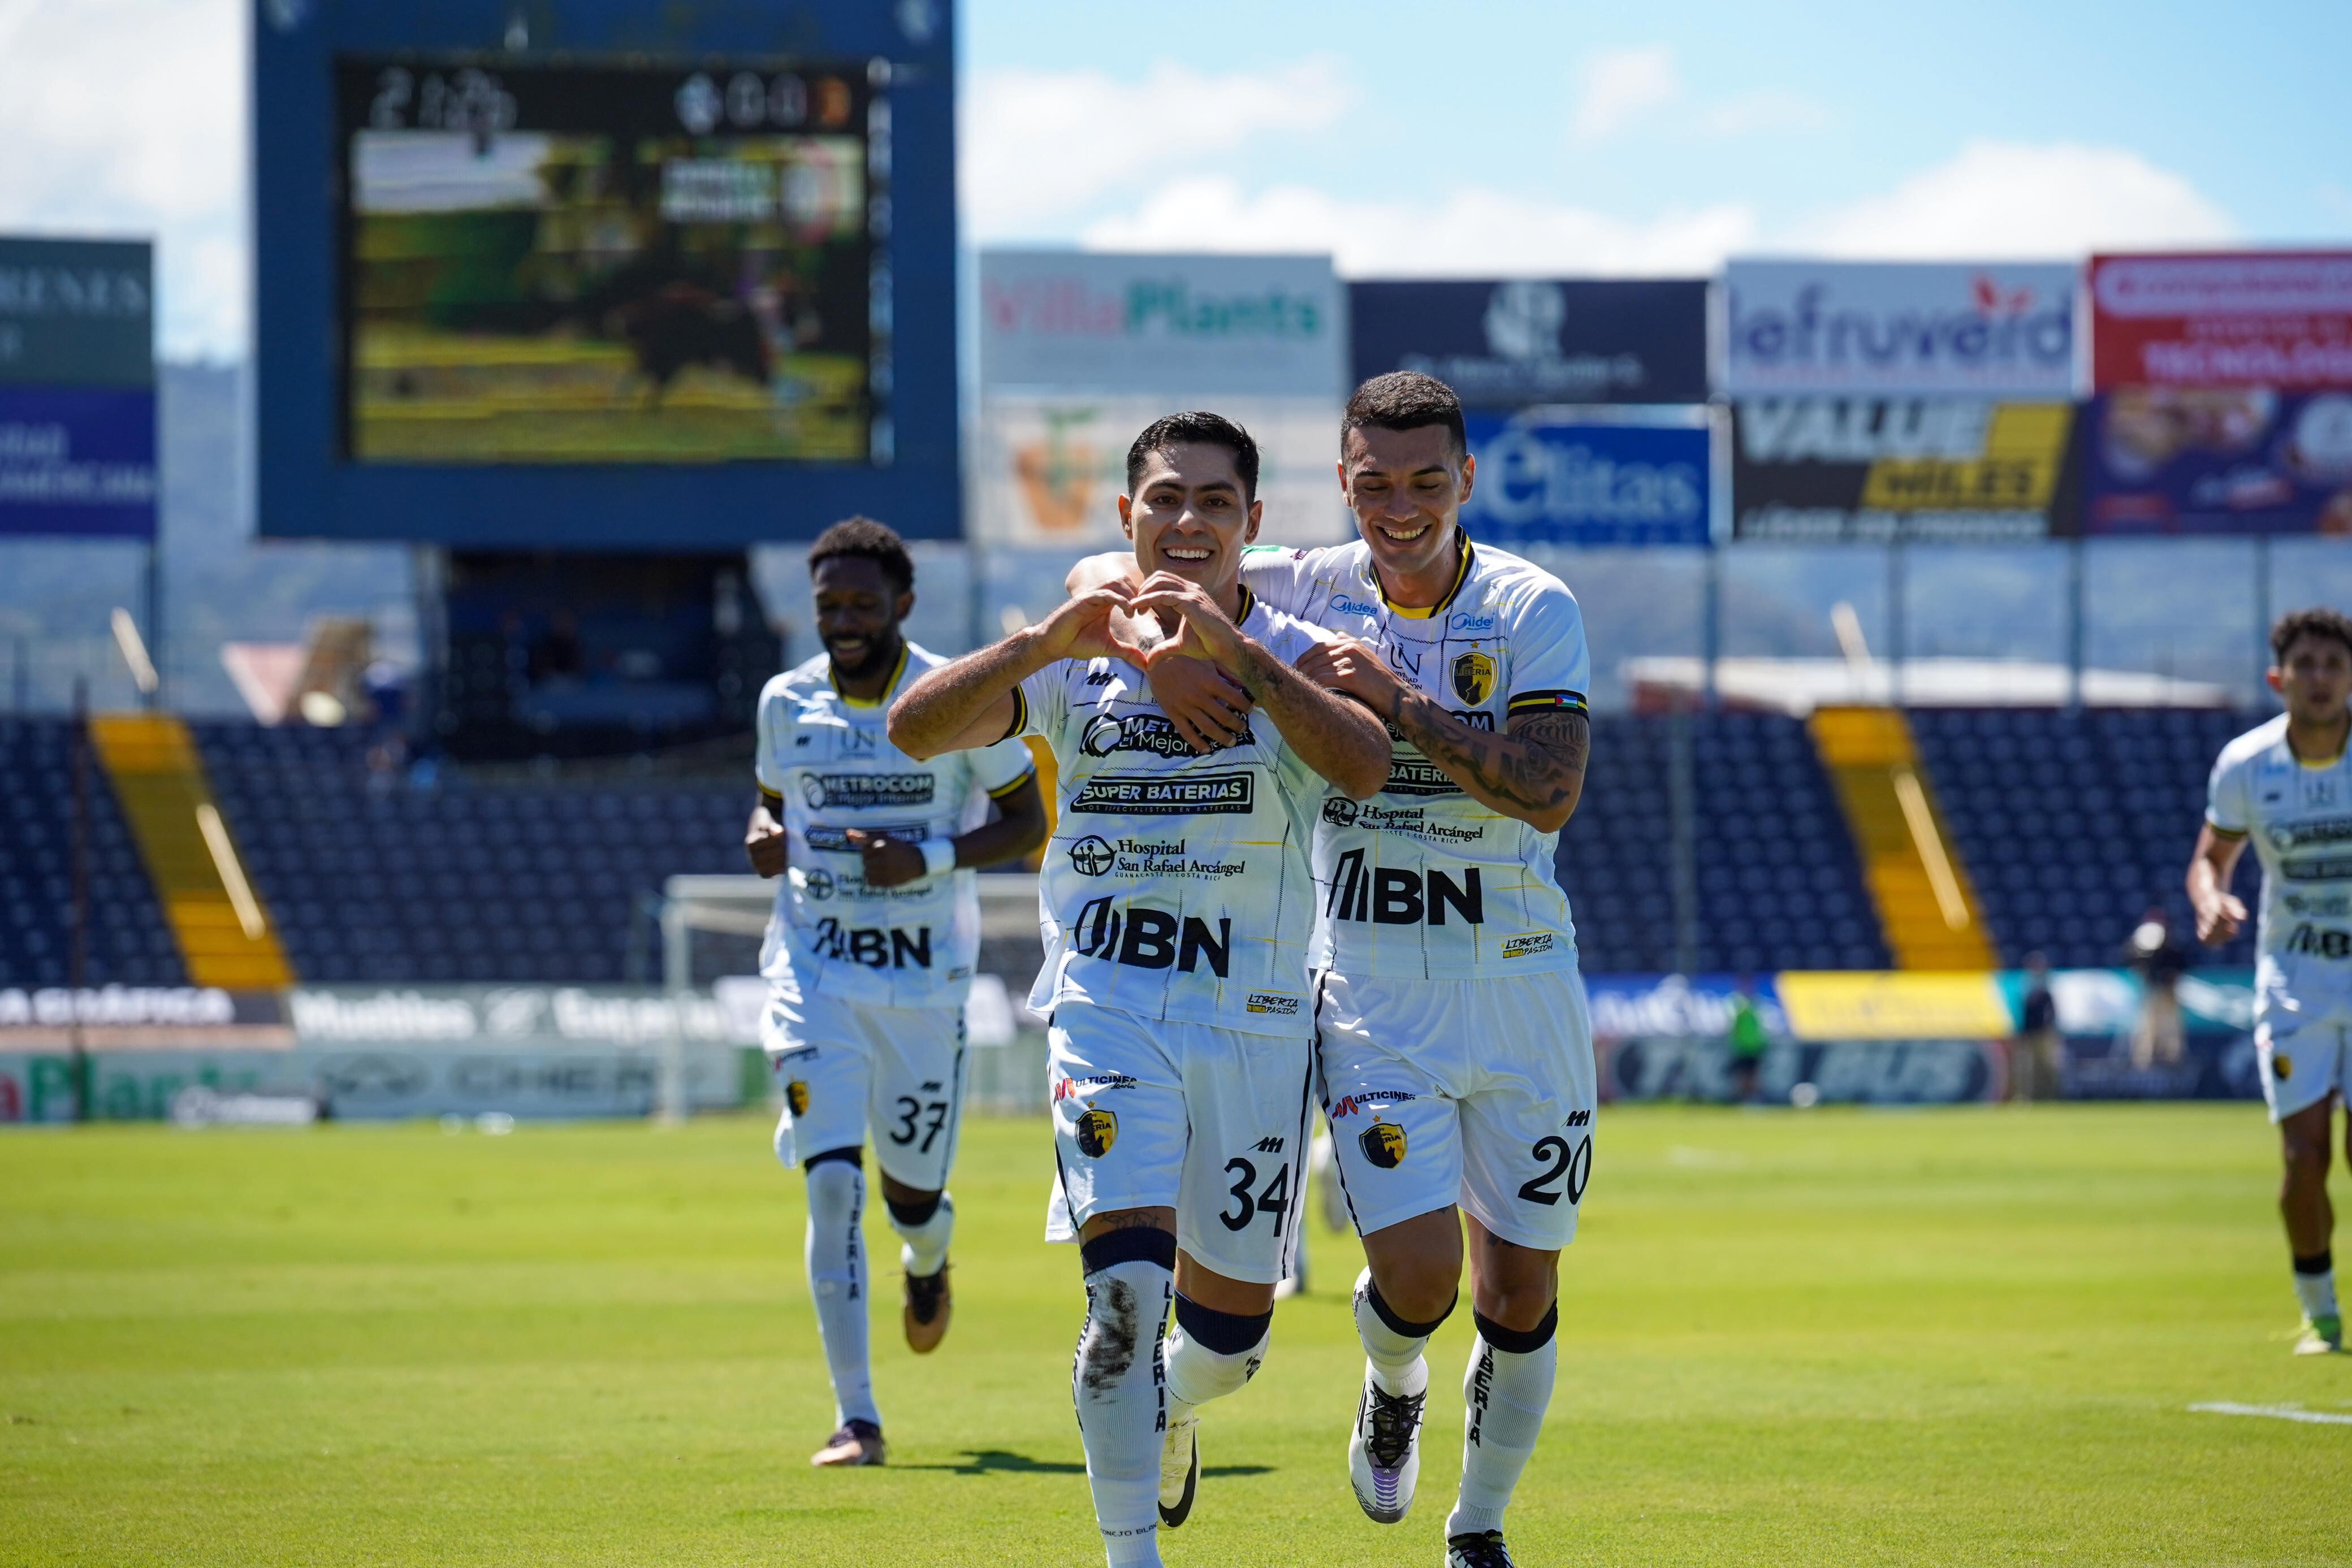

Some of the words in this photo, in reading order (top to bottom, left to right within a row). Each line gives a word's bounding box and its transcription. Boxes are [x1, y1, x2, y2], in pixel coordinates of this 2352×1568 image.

[984, 277, 1318, 337] VillaPlants
[1744, 400, 1986, 459] VALUE
[1330, 595, 1378, 615] Midea
[1139, 733, 1188, 754] Mejor
[824, 776, 932, 791] METROCOM
[1082, 785, 1141, 800] SUPER
[1147, 782, 1242, 800] BATERIAS
[1361, 804, 1424, 822] Hospital
[1414, 833, 1437, 842] COSTA
[1427, 822, 1483, 842] Arcángel
[1117, 838, 1186, 860] Hospital
[1117, 857, 1139, 871] San
[1143, 859, 1186, 872] Rafael
[1190, 860, 1246, 877] Arcángel
[890, 1096, 949, 1154] 37
[1517, 1133, 1592, 1206] 20
[1219, 1157, 1289, 1237] 34
[846, 1175, 861, 1301] LIBERIA
[1153, 1280, 1173, 1433] LIBERIA
